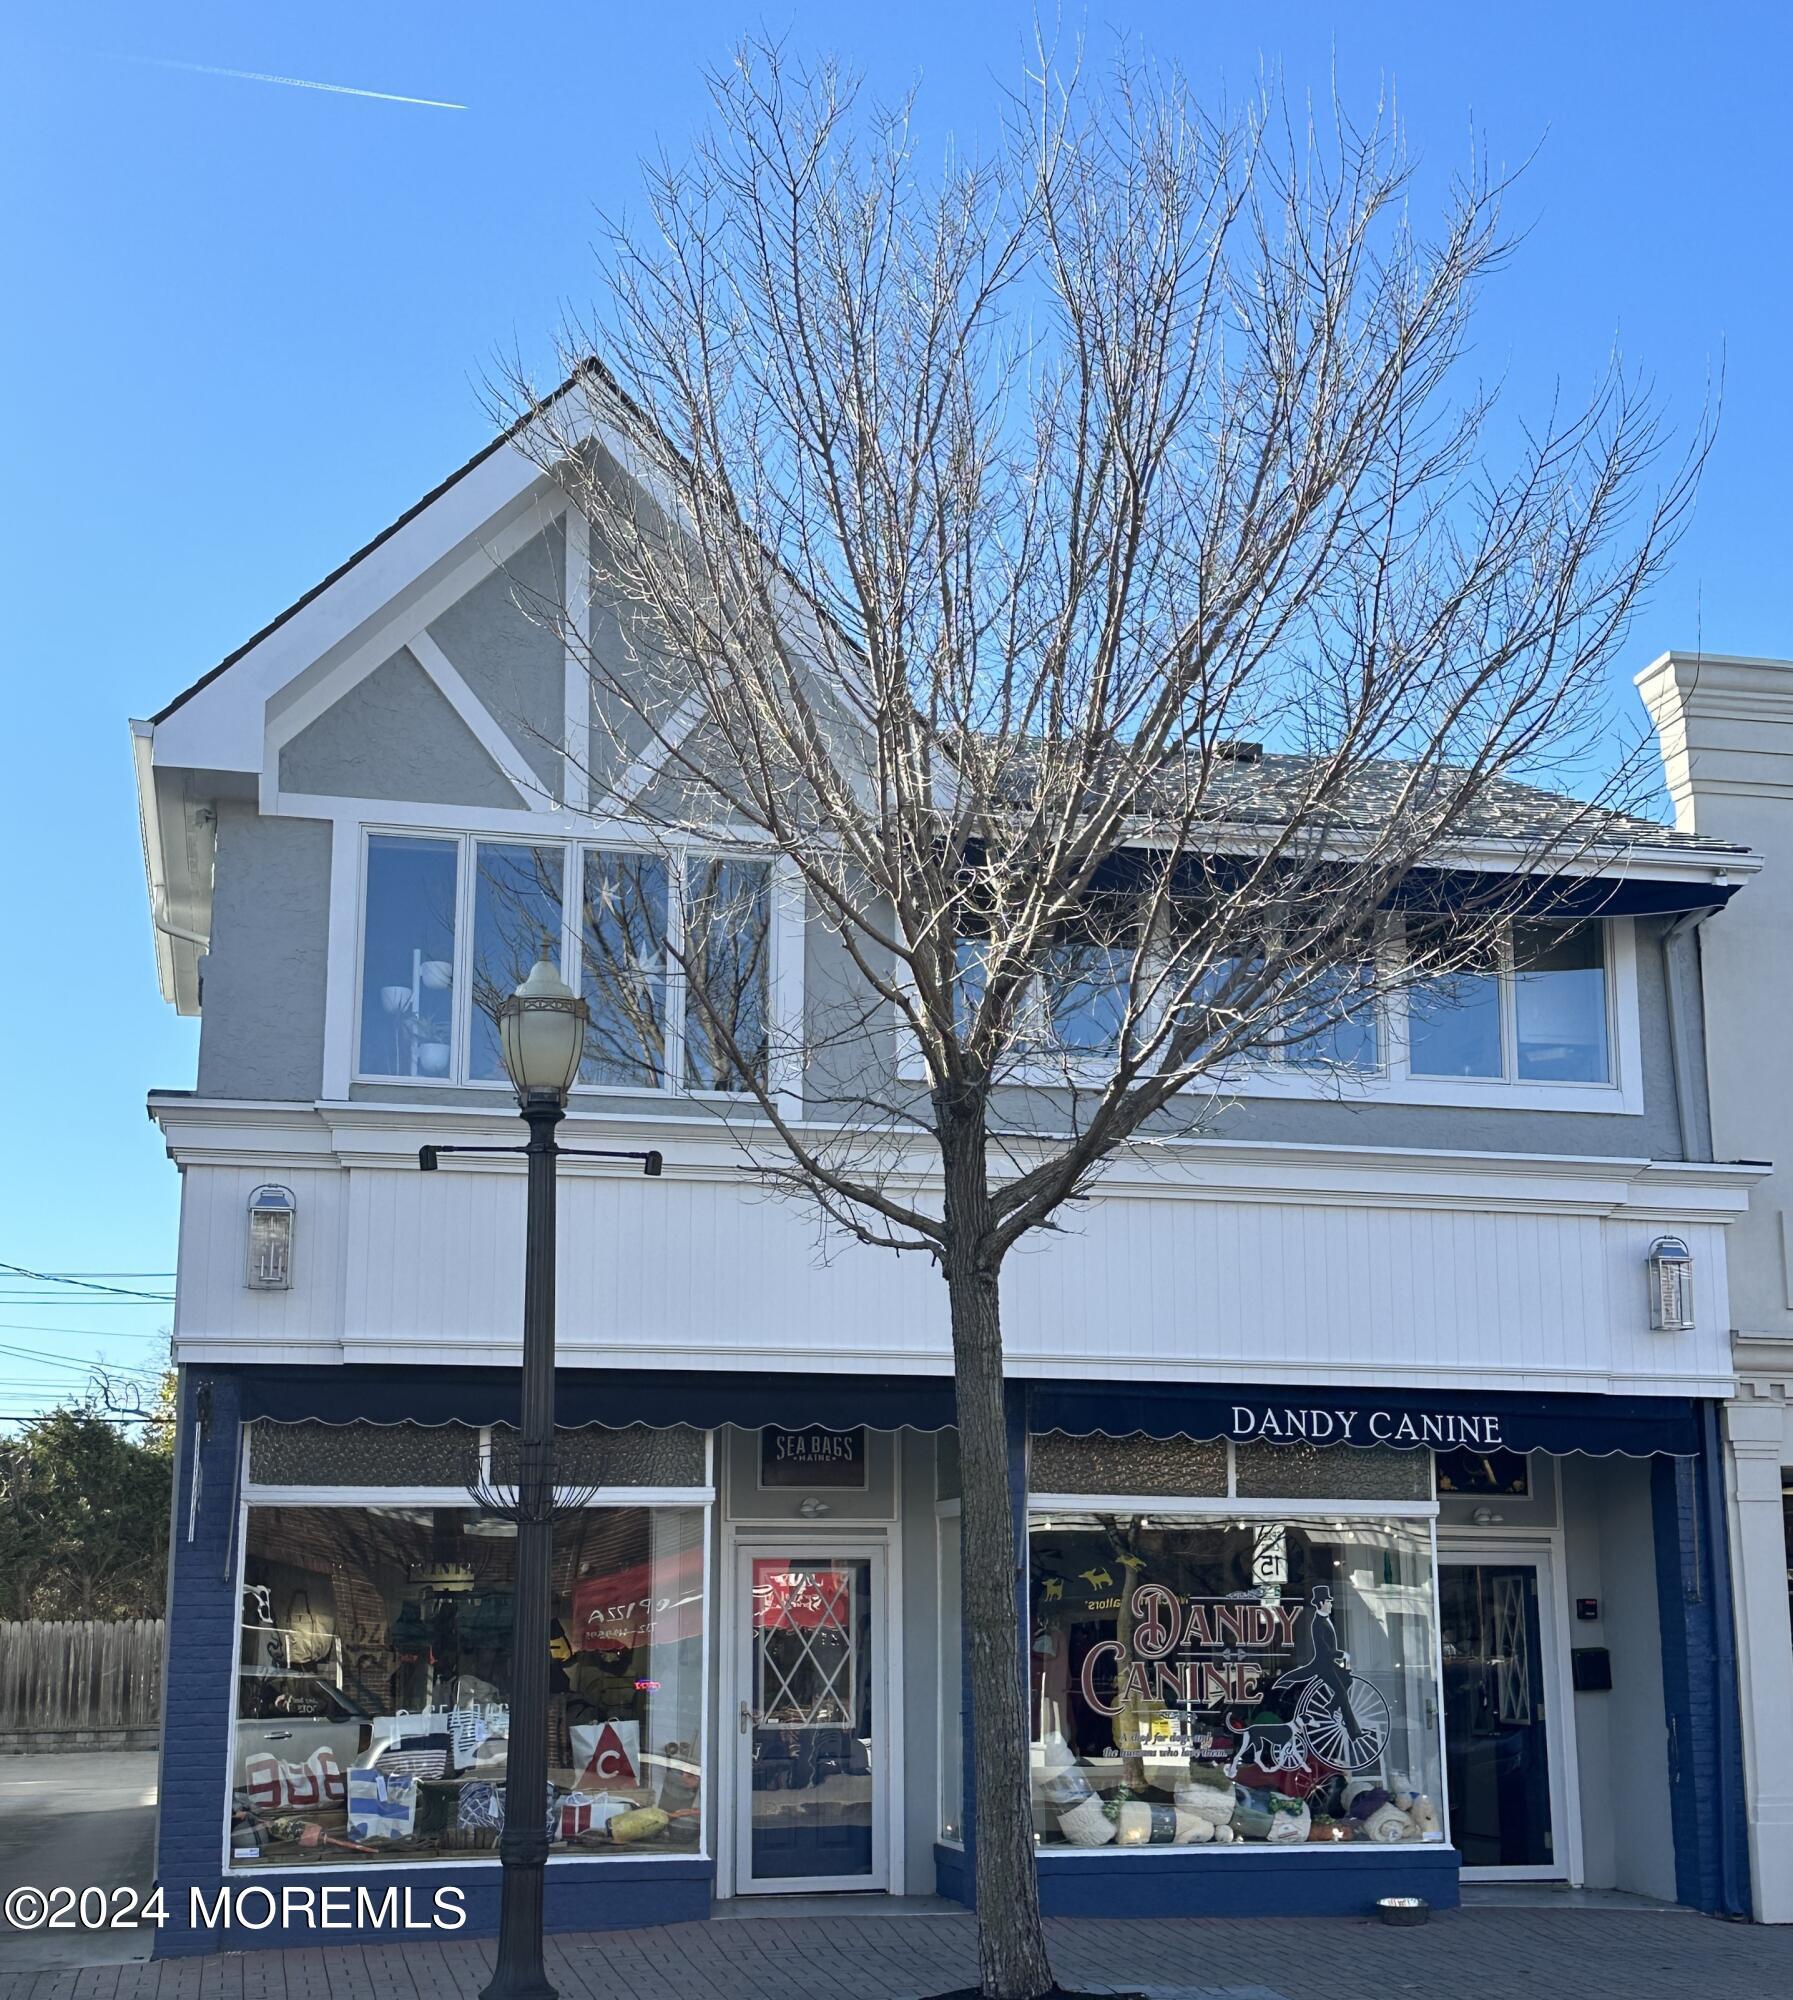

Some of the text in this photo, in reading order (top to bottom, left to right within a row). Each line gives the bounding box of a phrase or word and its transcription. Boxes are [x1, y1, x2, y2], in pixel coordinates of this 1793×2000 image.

[1232, 1406, 1502, 1443] DANDY CANINE
[777, 1436, 853, 1461] SEA BAGS
[1131, 1584, 1304, 1659] DANDY
[1081, 1640, 1264, 1715] CANINE
[1152, 1732, 1168, 1744] for
[1160, 1747, 1178, 1757] who
[596, 1750, 620, 1779] C
